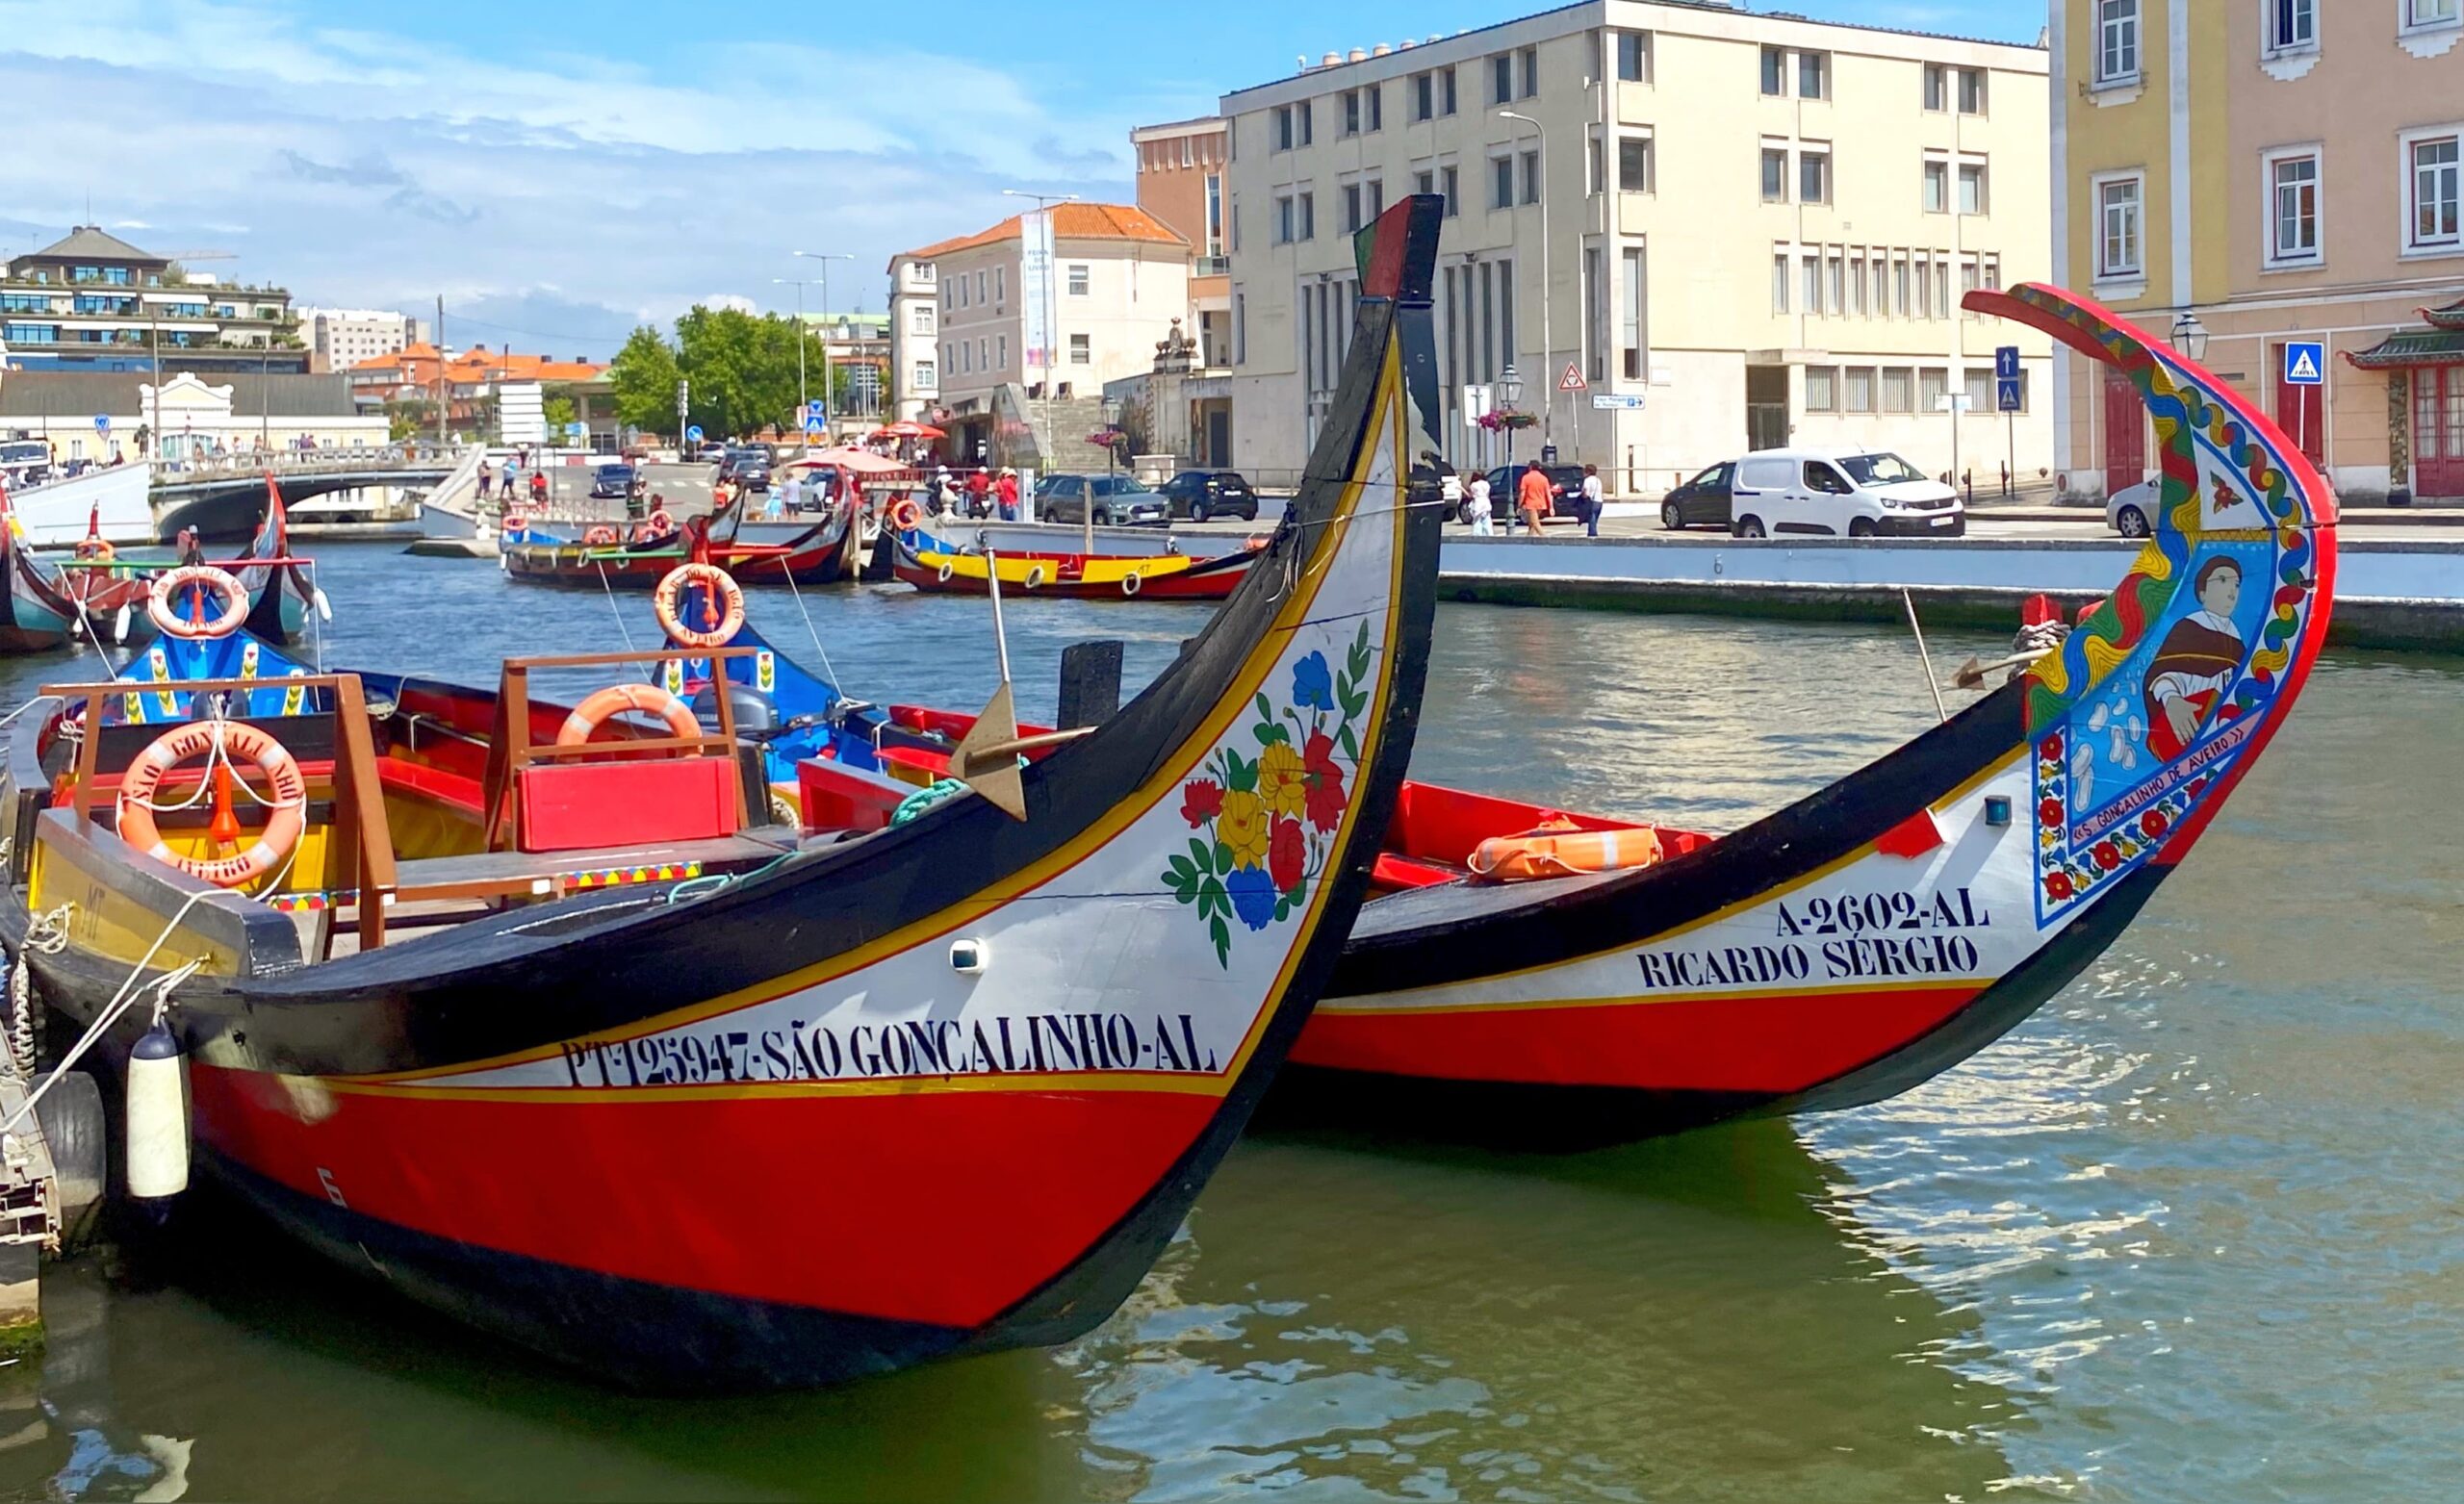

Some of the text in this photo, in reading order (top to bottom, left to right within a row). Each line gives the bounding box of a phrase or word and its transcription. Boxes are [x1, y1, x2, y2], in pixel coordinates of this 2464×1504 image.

[2168, 765, 2184, 783] DE
[1777, 888, 1989, 937] A-2602-AL
[1637, 929, 1978, 988] RICARDO SÉRGIO
